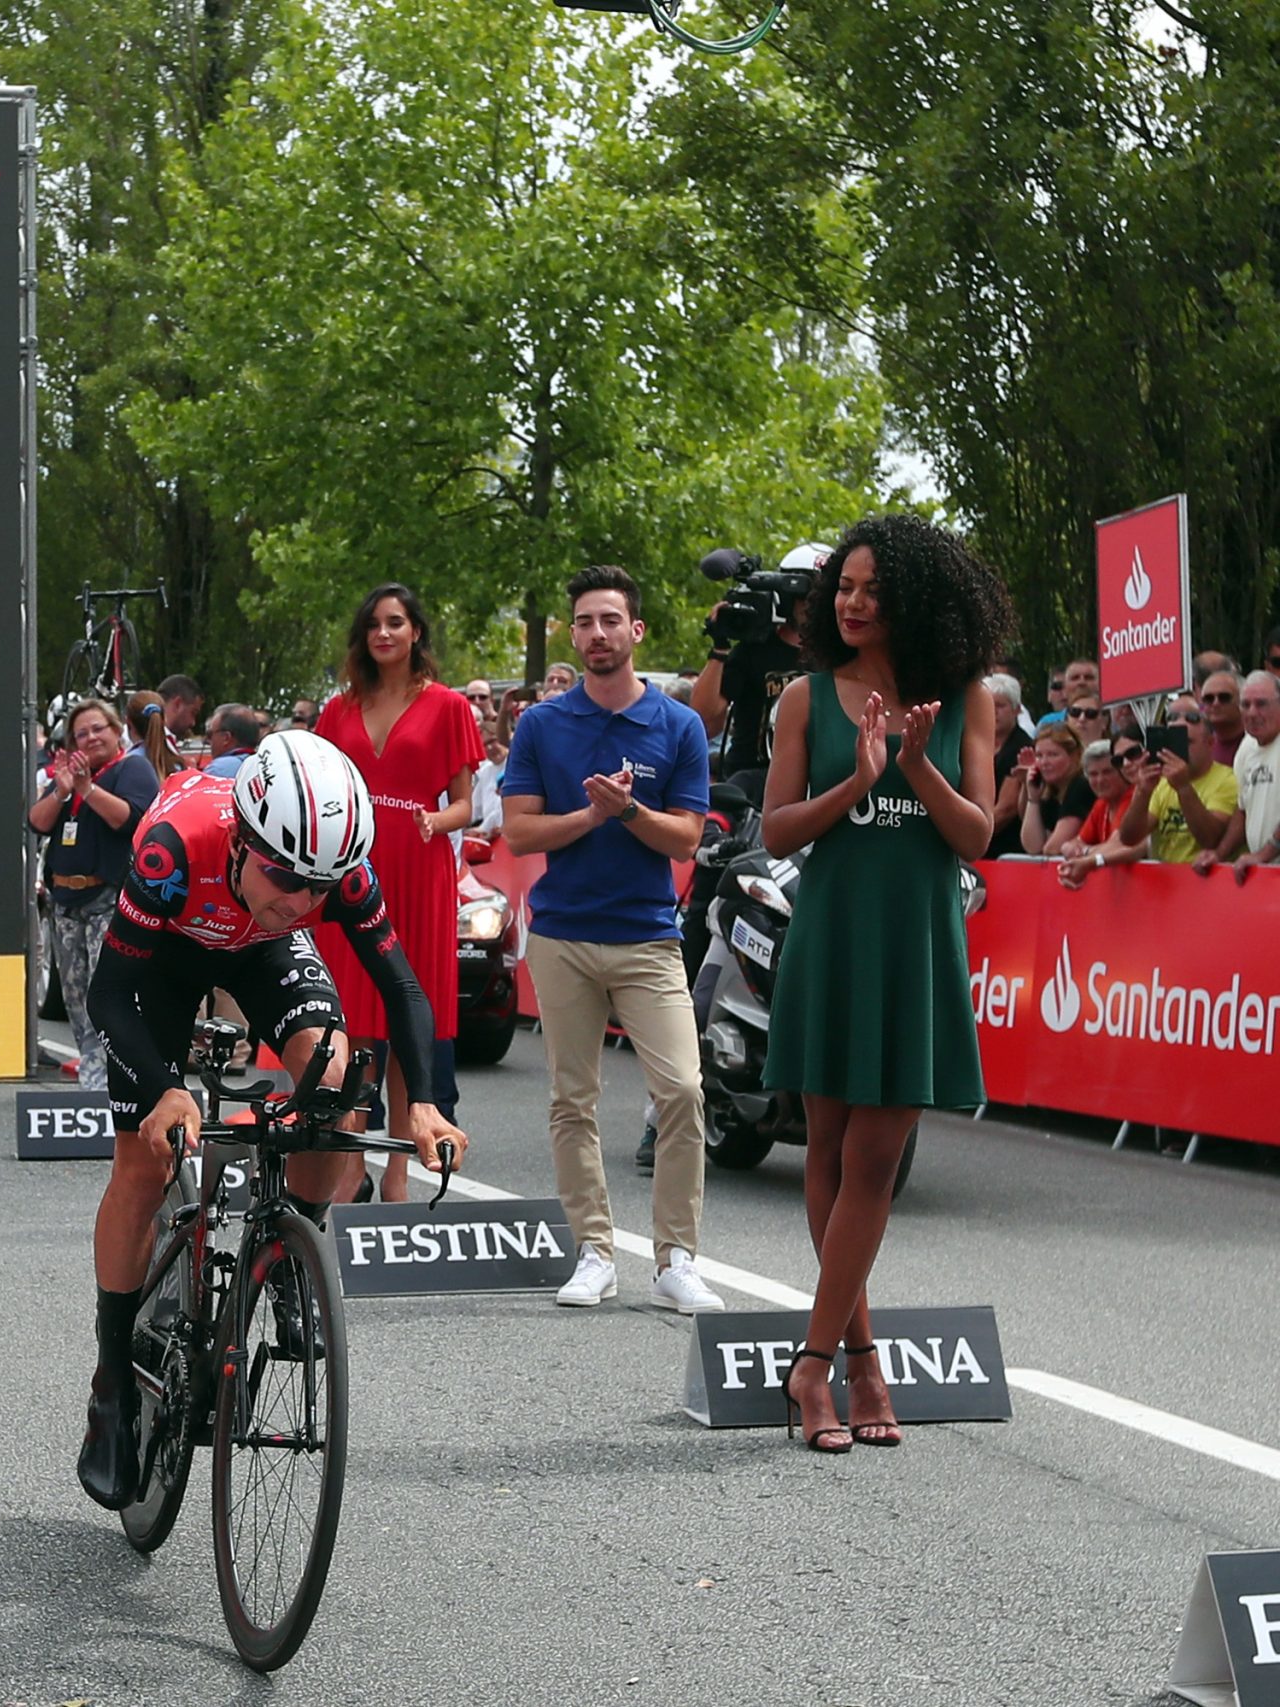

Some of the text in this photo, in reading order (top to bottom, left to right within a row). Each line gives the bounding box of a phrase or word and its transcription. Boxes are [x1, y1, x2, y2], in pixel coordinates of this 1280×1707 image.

[1102, 611, 1177, 660] Santander
[747, 937, 771, 959] RTP
[1084, 961, 1280, 1055] Santander
[26, 1107, 116, 1139] FEST
[345, 1220, 565, 1266] FESTINA
